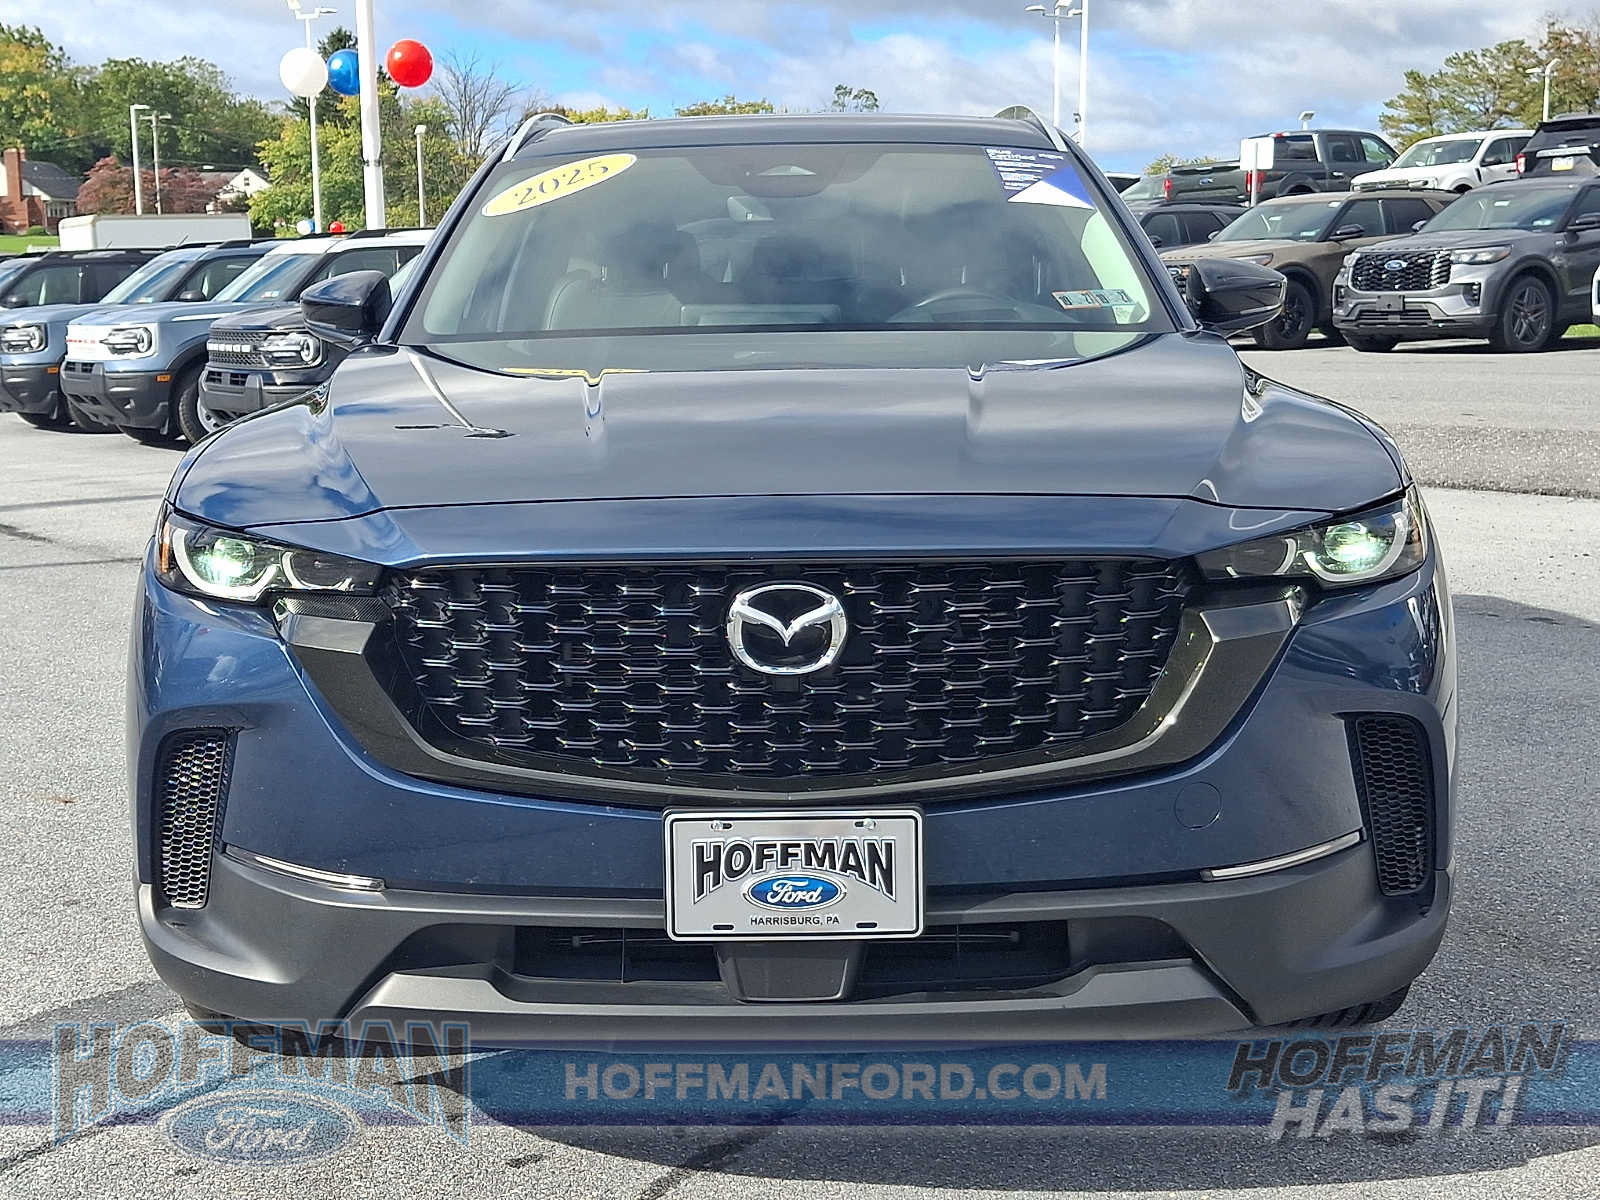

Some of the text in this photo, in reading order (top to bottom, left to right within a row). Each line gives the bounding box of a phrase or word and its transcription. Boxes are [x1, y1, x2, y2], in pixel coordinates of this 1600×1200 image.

[513, 160, 609, 206] 2025
[692, 838, 897, 904] HOFFMAN
[766, 879, 823, 903] Ford
[750, 916, 840, 926] HARRISBURG, PA
